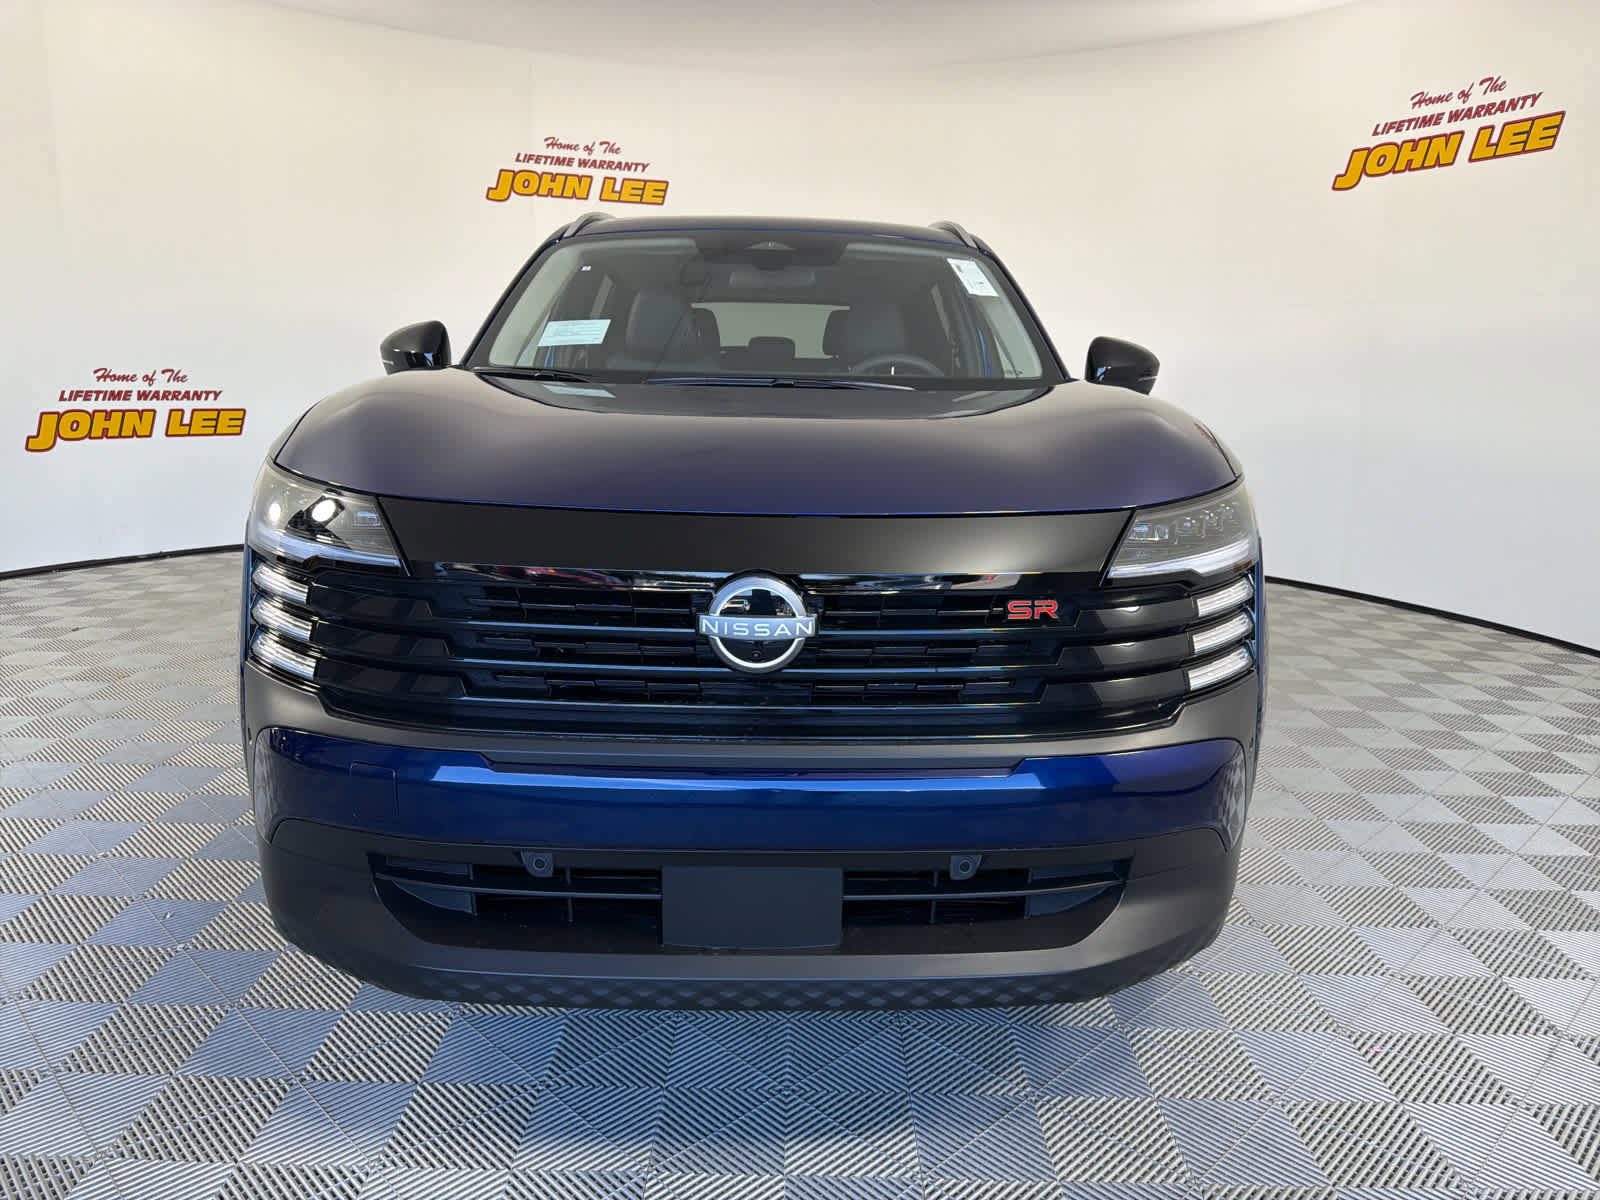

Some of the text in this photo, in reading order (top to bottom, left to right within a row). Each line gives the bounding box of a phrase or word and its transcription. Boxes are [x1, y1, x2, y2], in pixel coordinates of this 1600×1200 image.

[1410, 75, 1507, 109] Home of The
[1372, 91, 1544, 137] LIFETIME WARRANTY
[544, 136, 622, 155] Home of The
[1331, 110, 1566, 191] JOHN LEE
[515, 153, 650, 173] LIFETIME WARRANTY
[486, 169, 669, 206] JOHN LEE
[93, 368, 189, 386] Home of The
[58, 390, 223, 402] LIFETIME WARRANTY
[25, 408, 246, 453] JOHN LEE
[1008, 600, 1058, 619] SR
[702, 619, 813, 636] NISSAN
